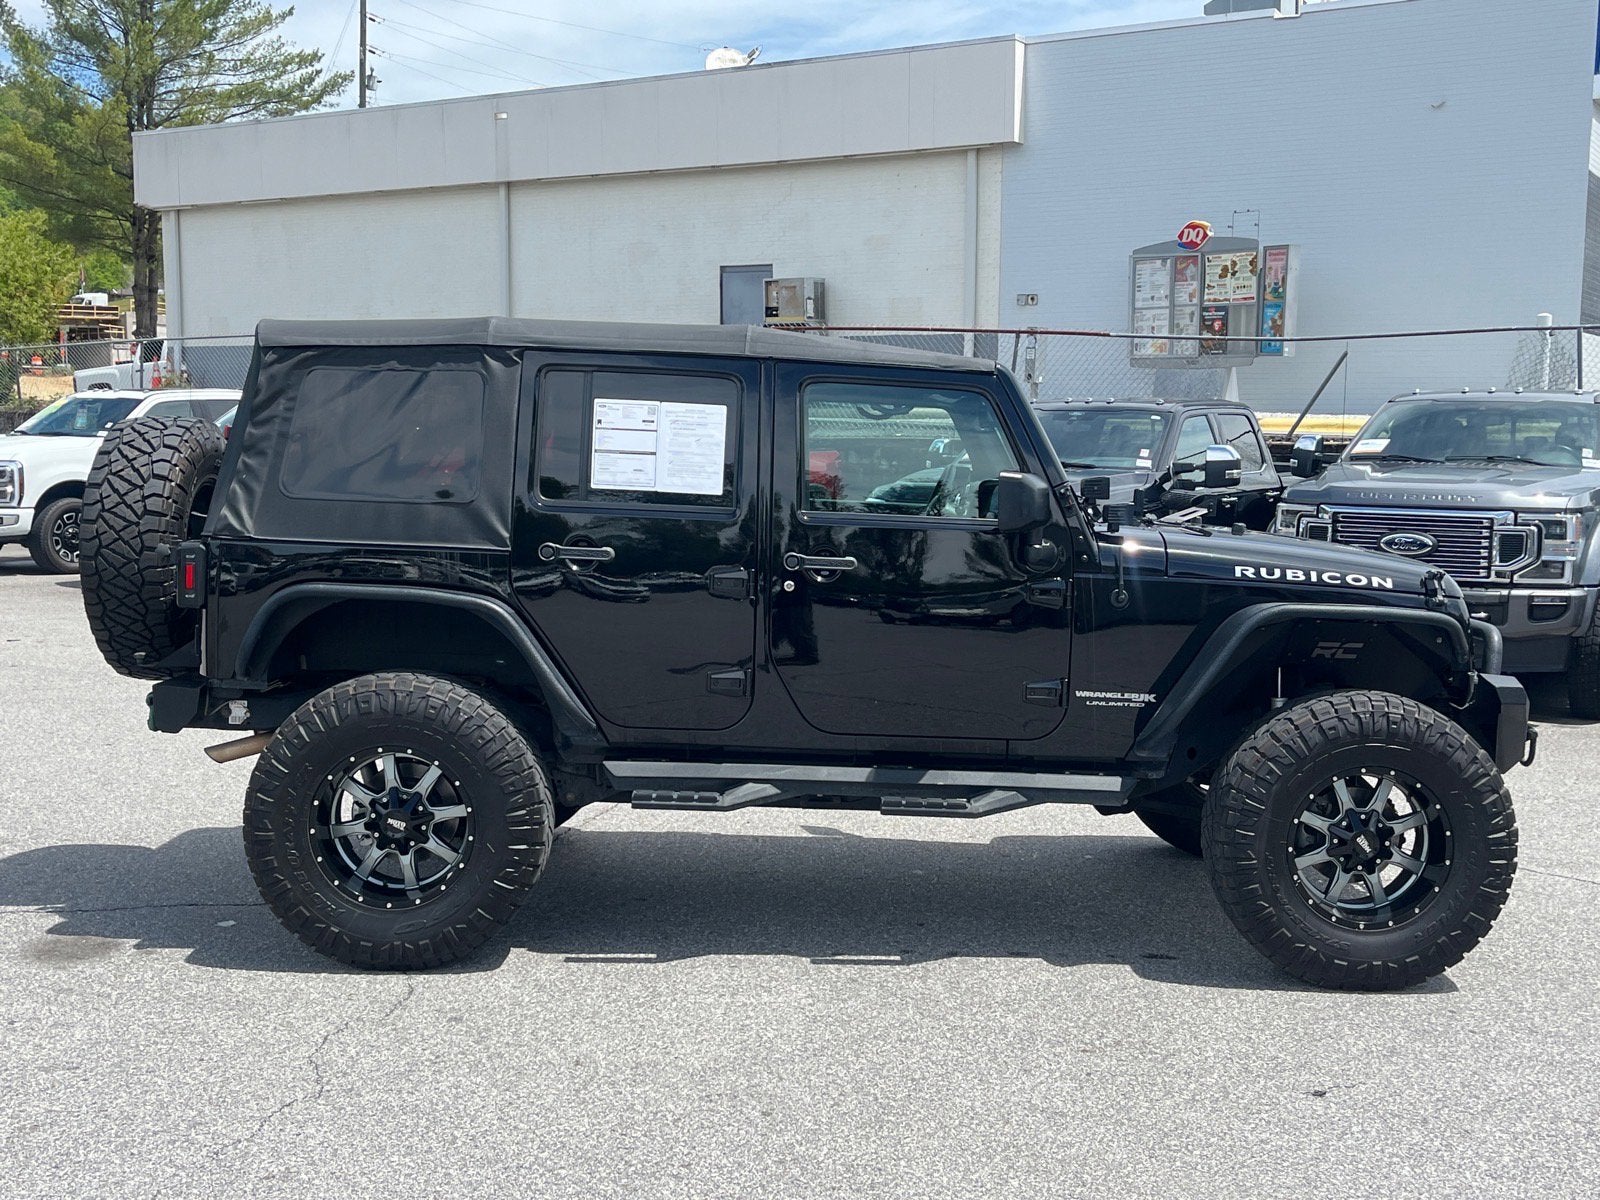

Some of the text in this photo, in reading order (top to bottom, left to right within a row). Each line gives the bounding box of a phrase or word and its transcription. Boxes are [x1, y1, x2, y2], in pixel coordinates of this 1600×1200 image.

[1182, 228, 1203, 244] DQ
[1391, 537, 1420, 550] Ford
[1234, 565, 1393, 589] RUBICON
[1310, 641, 1364, 659] RC
